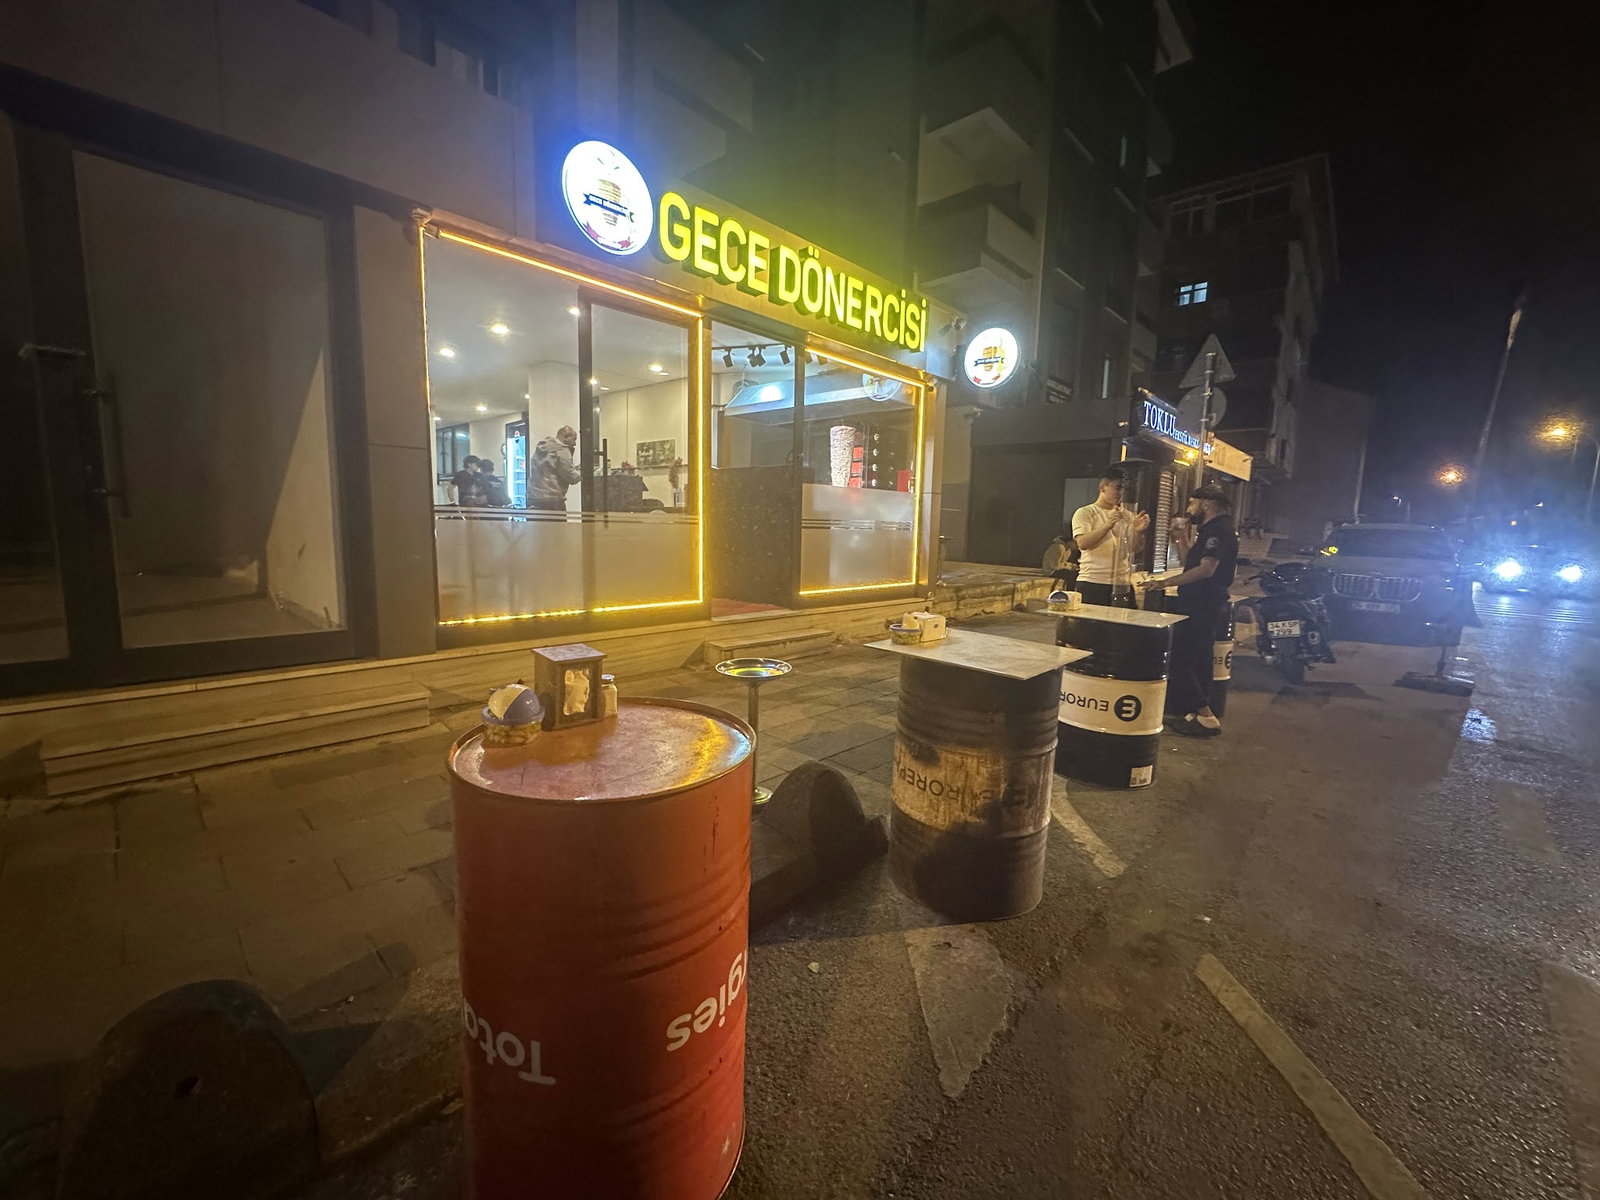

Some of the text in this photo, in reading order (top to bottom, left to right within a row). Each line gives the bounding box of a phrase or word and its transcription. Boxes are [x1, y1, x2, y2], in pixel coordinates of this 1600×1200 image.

[659, 191, 927, 352] GECE DÖNERCİSİ
[1143, 400, 1176, 437] TOKLU
